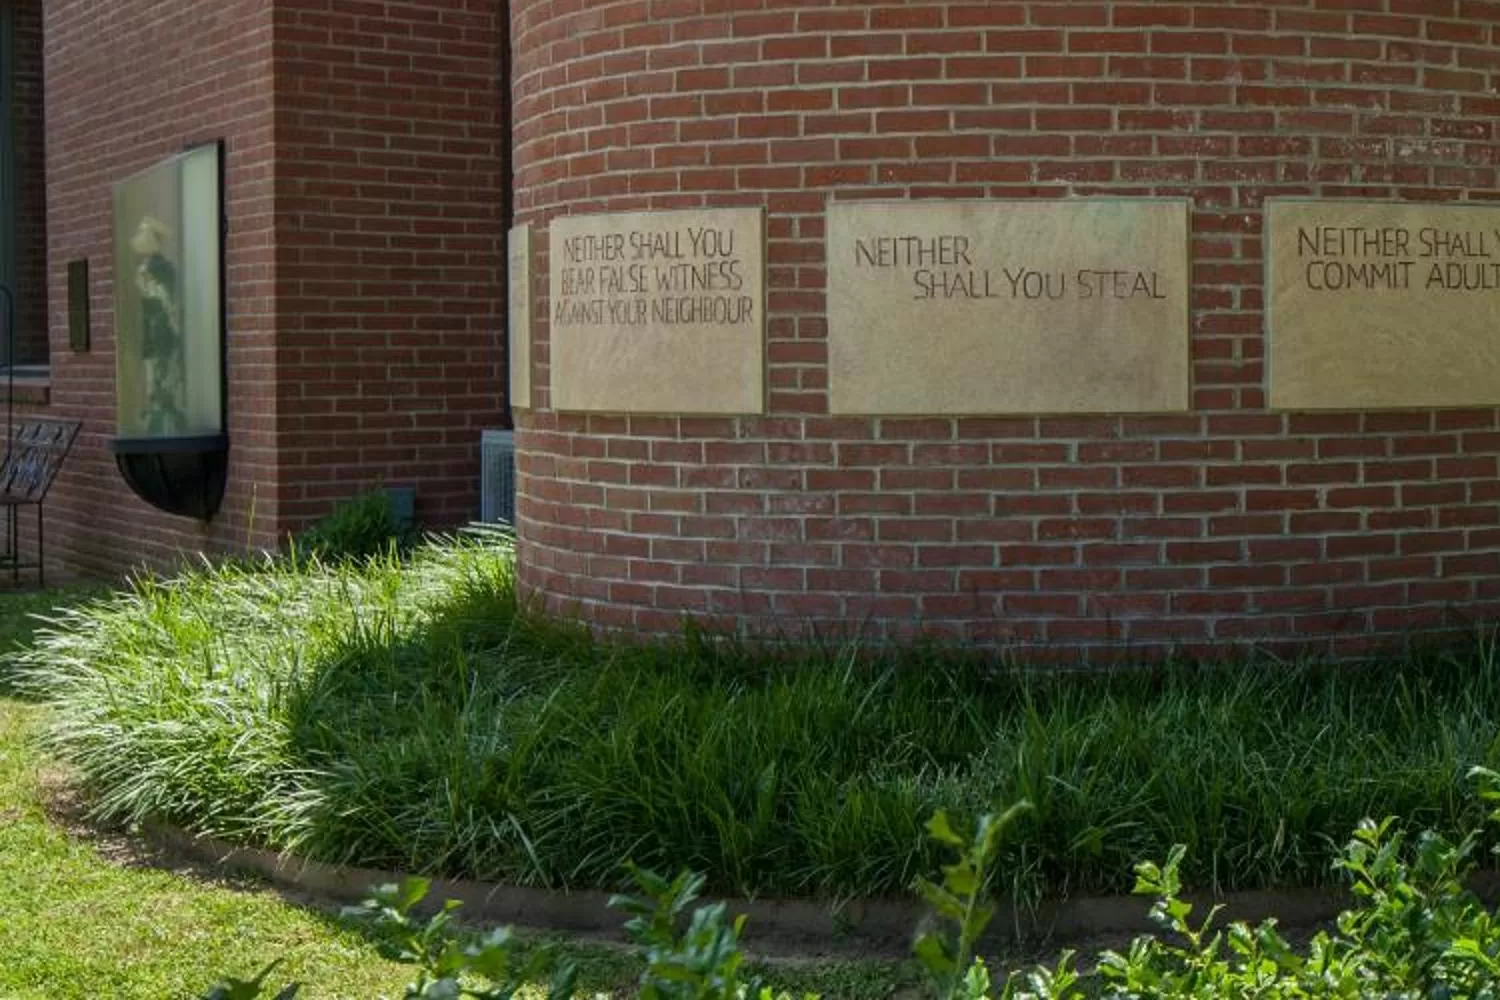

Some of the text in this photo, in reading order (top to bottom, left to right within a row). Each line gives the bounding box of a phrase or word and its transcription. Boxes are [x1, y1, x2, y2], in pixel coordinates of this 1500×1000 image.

[563, 227, 734, 262] NEITHER SHALL YOU
[854, 235, 972, 267] NEITHER
[1297, 227, 1409, 257] NEITHER
[1419, 227, 1491, 258] SHALL
[561, 266, 595, 296] BEAR
[599, 263, 649, 294] FALSE
[654, 260, 743, 292] WITNESS
[913, 267, 1166, 299] SHALL YOU STEAL
[1306, 261, 1416, 291] COMMIT
[607, 299, 647, 325] YOUR
[651, 295, 753, 325] NEIGHBOUR
